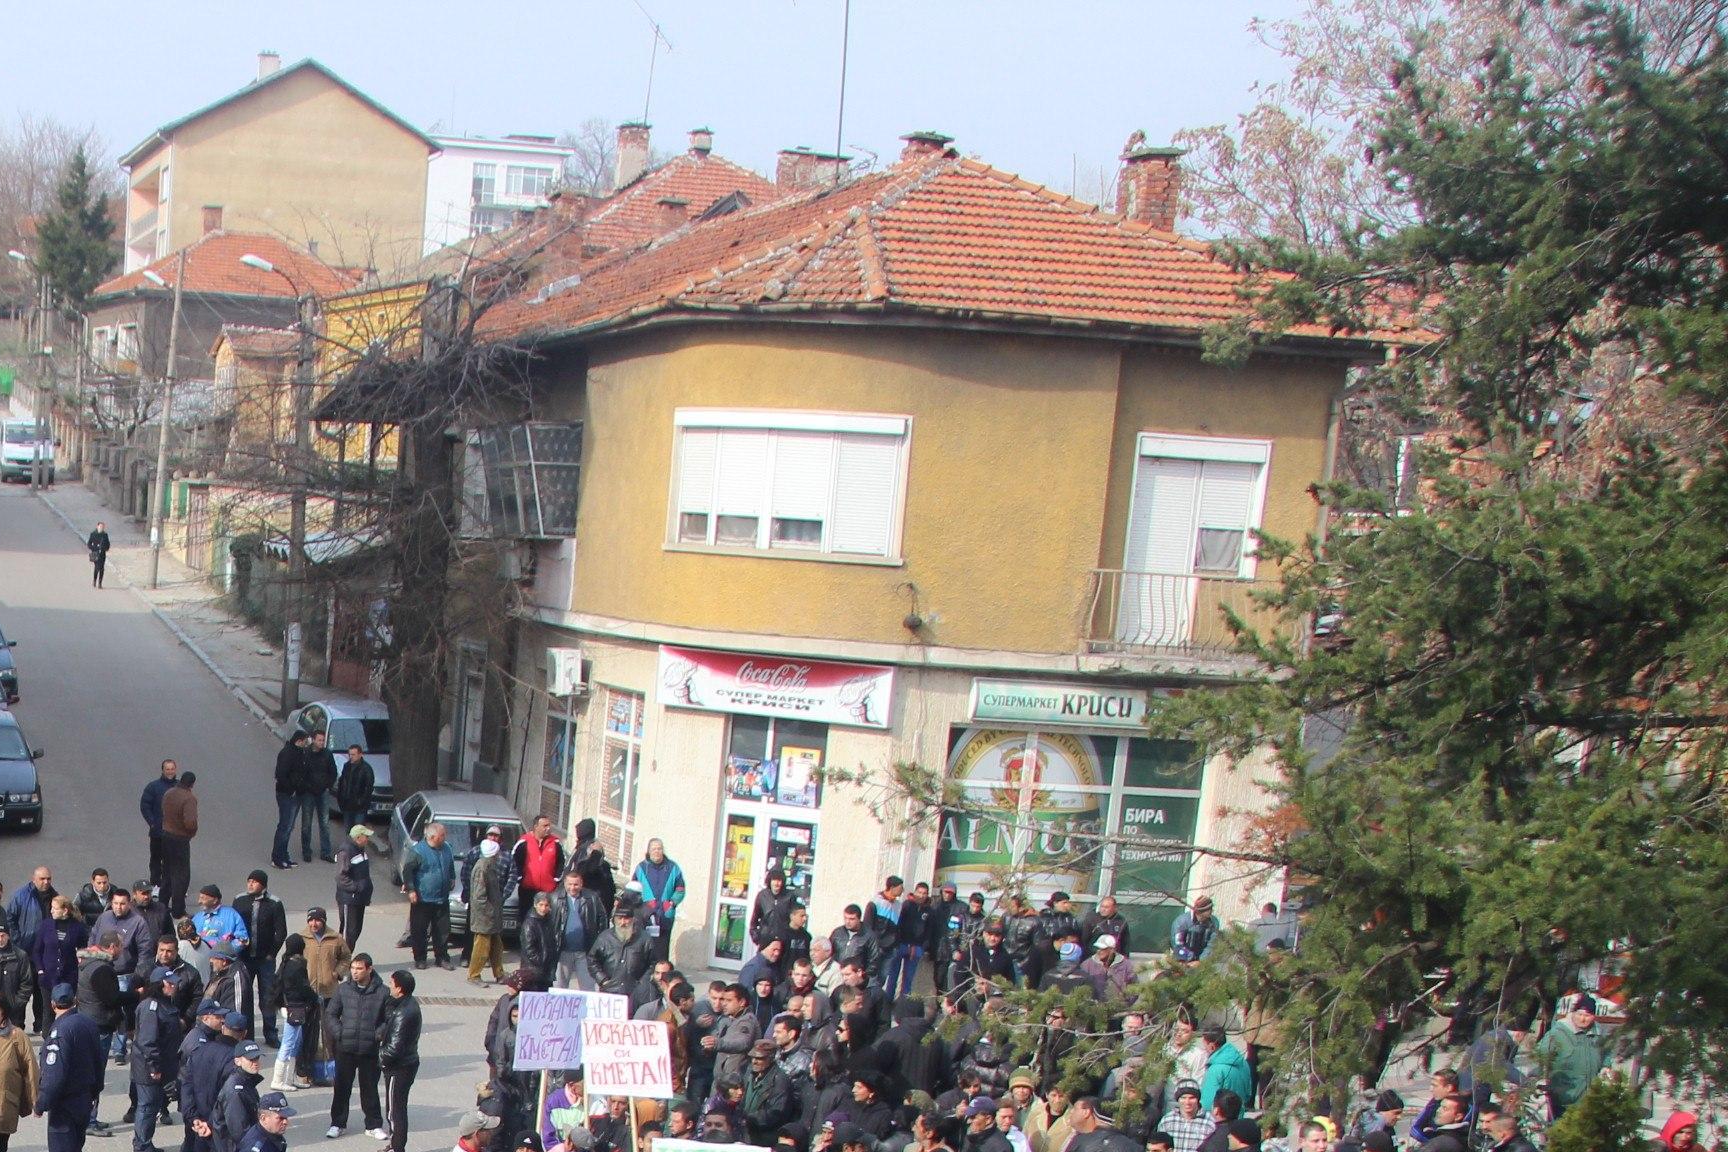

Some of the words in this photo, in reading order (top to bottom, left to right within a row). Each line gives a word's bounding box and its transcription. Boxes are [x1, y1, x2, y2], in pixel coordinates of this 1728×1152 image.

[736, 660, 812, 691] Coca-Cola
[729, 697, 812, 711] КРИСИ
[766, 693, 825, 706] МАРКЕТ
[983, 693, 1058, 710] СУПЕРМАРКЕТ
[1061, 693, 1133, 718] КРИСИ
[1124, 808, 1165, 824] БИРА
[1122, 825, 1138, 835] ПО
[584, 1022, 659, 1046] ИСКАМЕ
